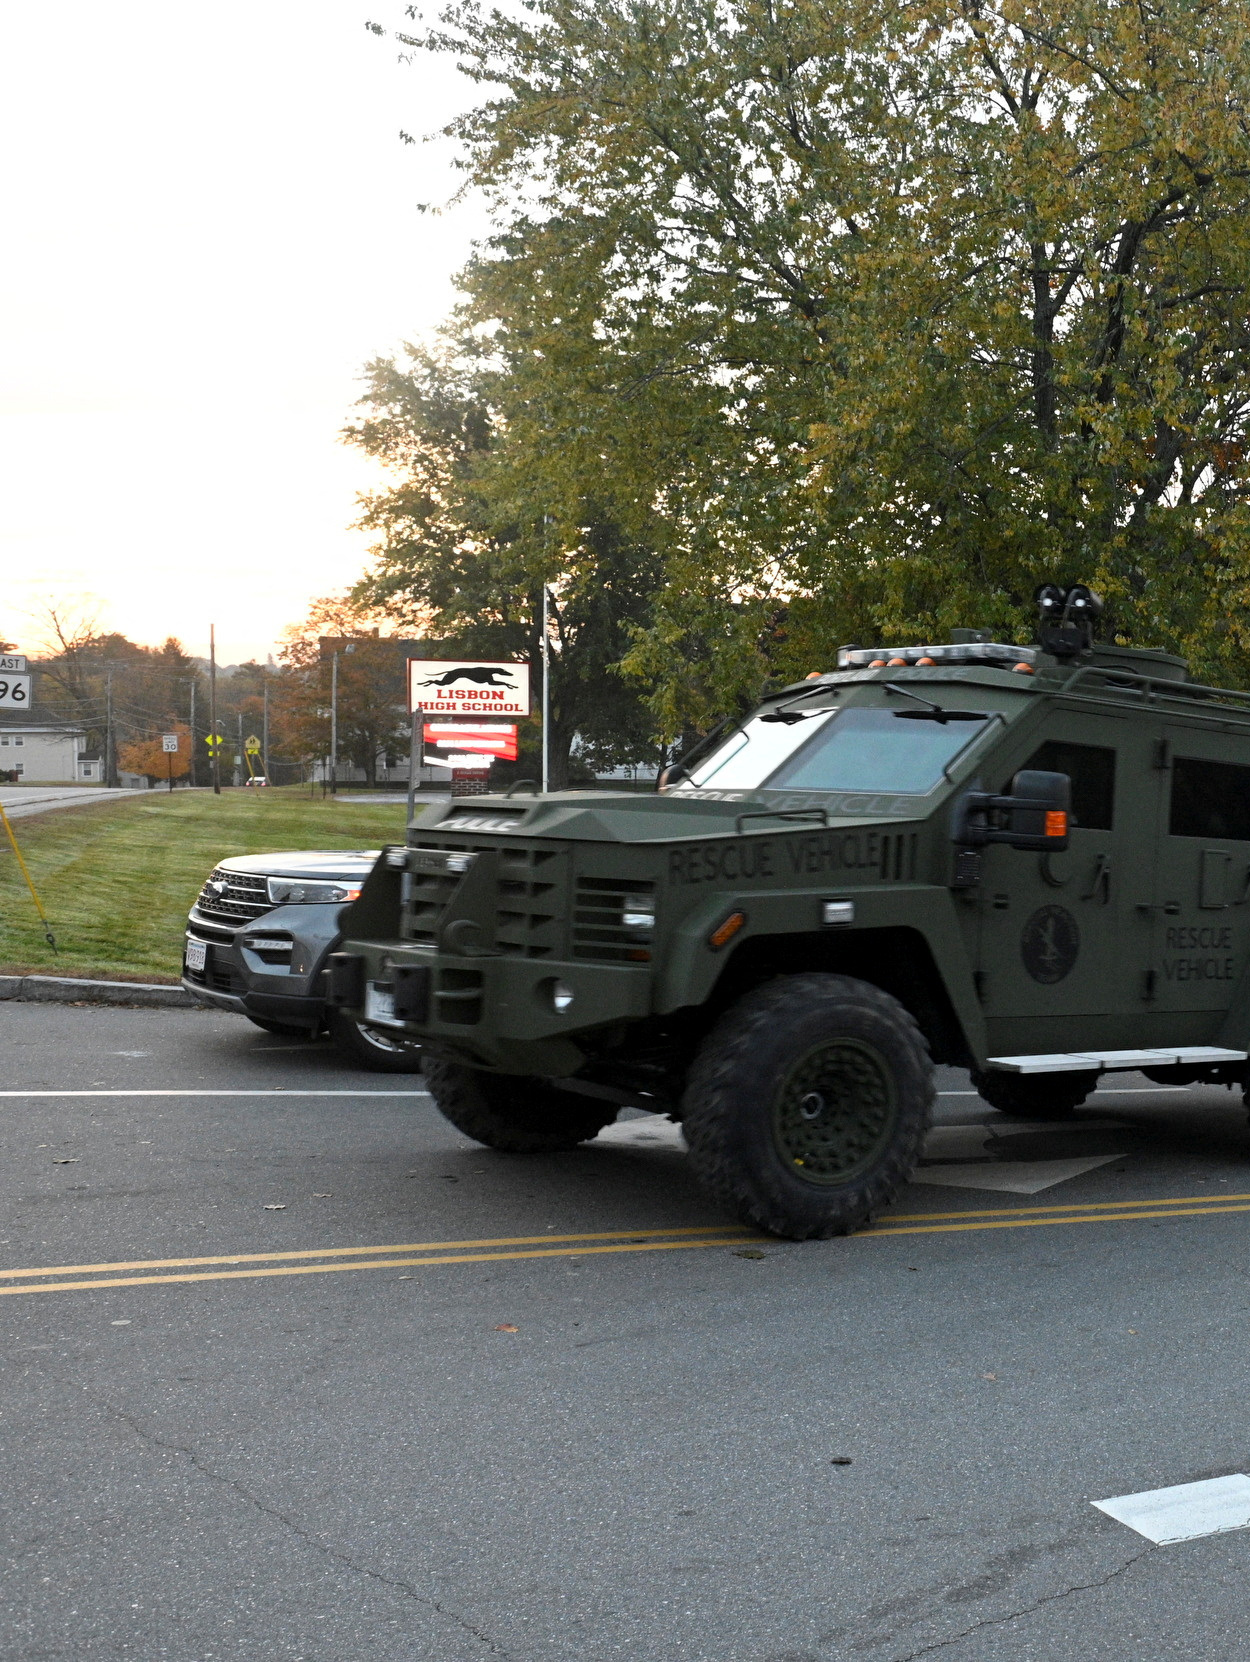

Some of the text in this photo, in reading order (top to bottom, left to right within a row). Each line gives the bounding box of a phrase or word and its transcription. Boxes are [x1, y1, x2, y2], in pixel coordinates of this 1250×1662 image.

[0, 658, 20, 669] AST
[0, 681, 26, 701] 96
[436, 689, 505, 700] LISBON
[418, 701, 524, 712] HIGH SCHOOL
[164, 743, 176, 751] 30
[755, 795, 911, 814] VEHICLE
[668, 832, 881, 885] RESCUE VEHICLE
[1166, 926, 1232, 949] RESCUE
[1163, 958, 1234, 981] VEHICLE
